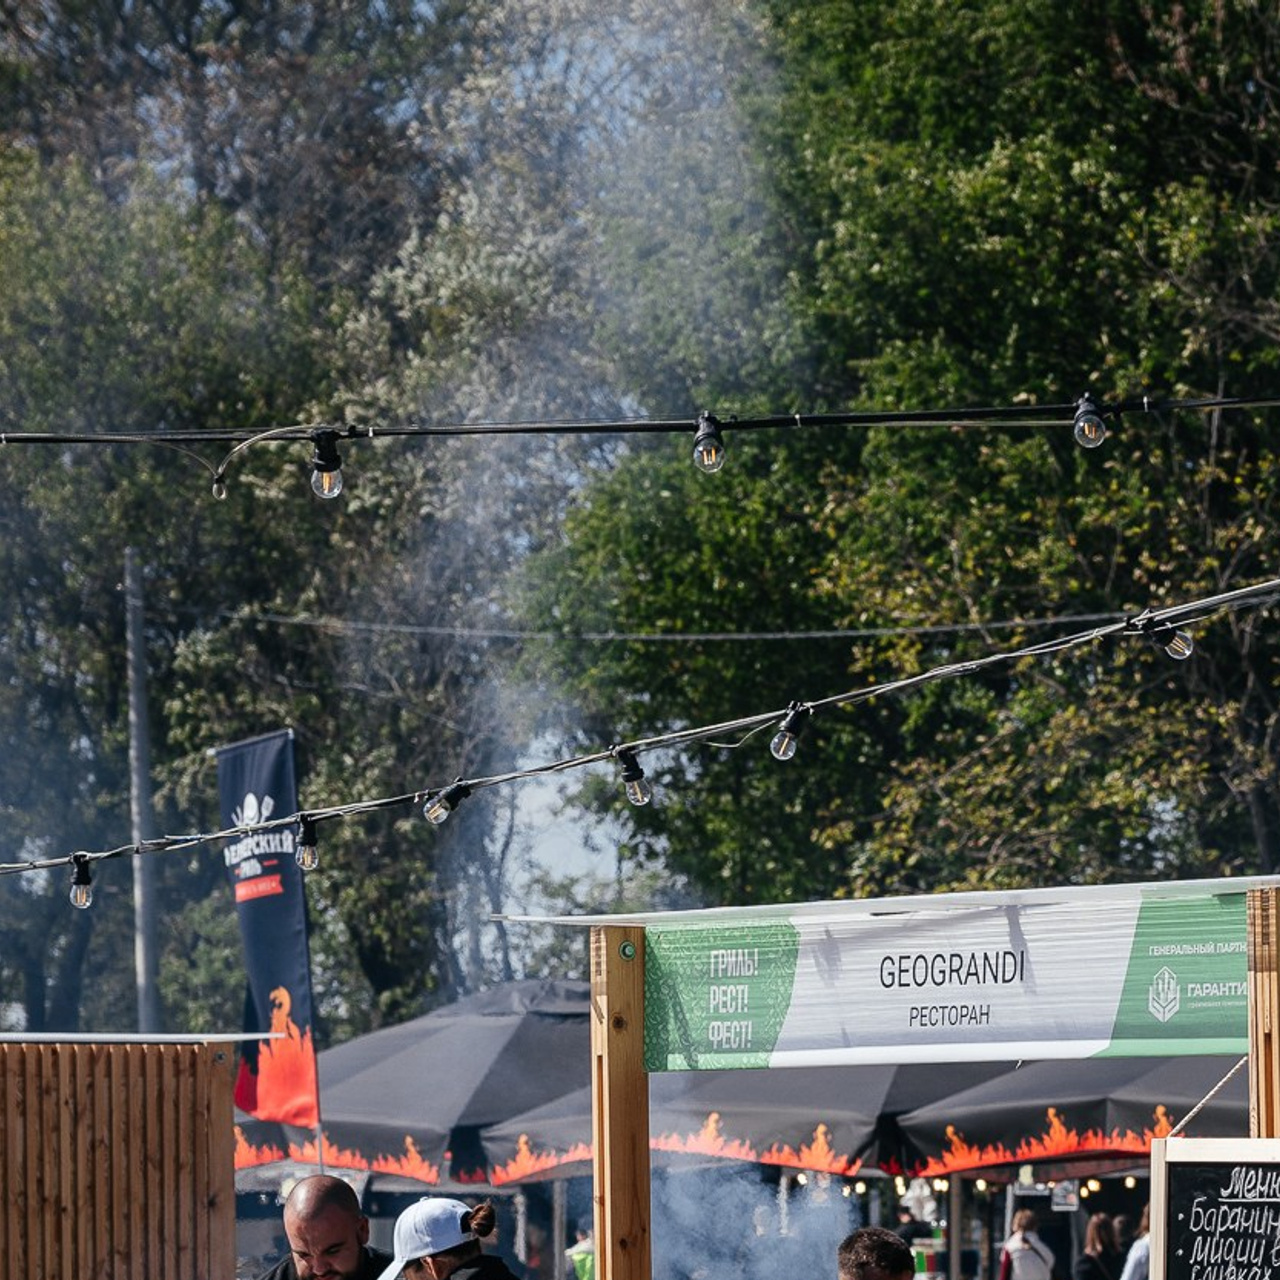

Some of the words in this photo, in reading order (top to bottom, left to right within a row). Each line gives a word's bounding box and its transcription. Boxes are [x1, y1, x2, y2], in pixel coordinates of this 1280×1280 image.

[710, 948, 759, 978] ГРИЛЬ!
[1148, 942, 1215, 957] ГЕНЕРАЛЬНЫЙ
[880, 950, 1024, 988] GEOGRANDI
[710, 984, 749, 1013] РЕСТ!
[910, 1004, 992, 1027] РЕСТОРАН
[708, 1021, 752, 1050] ФЕСТ!
